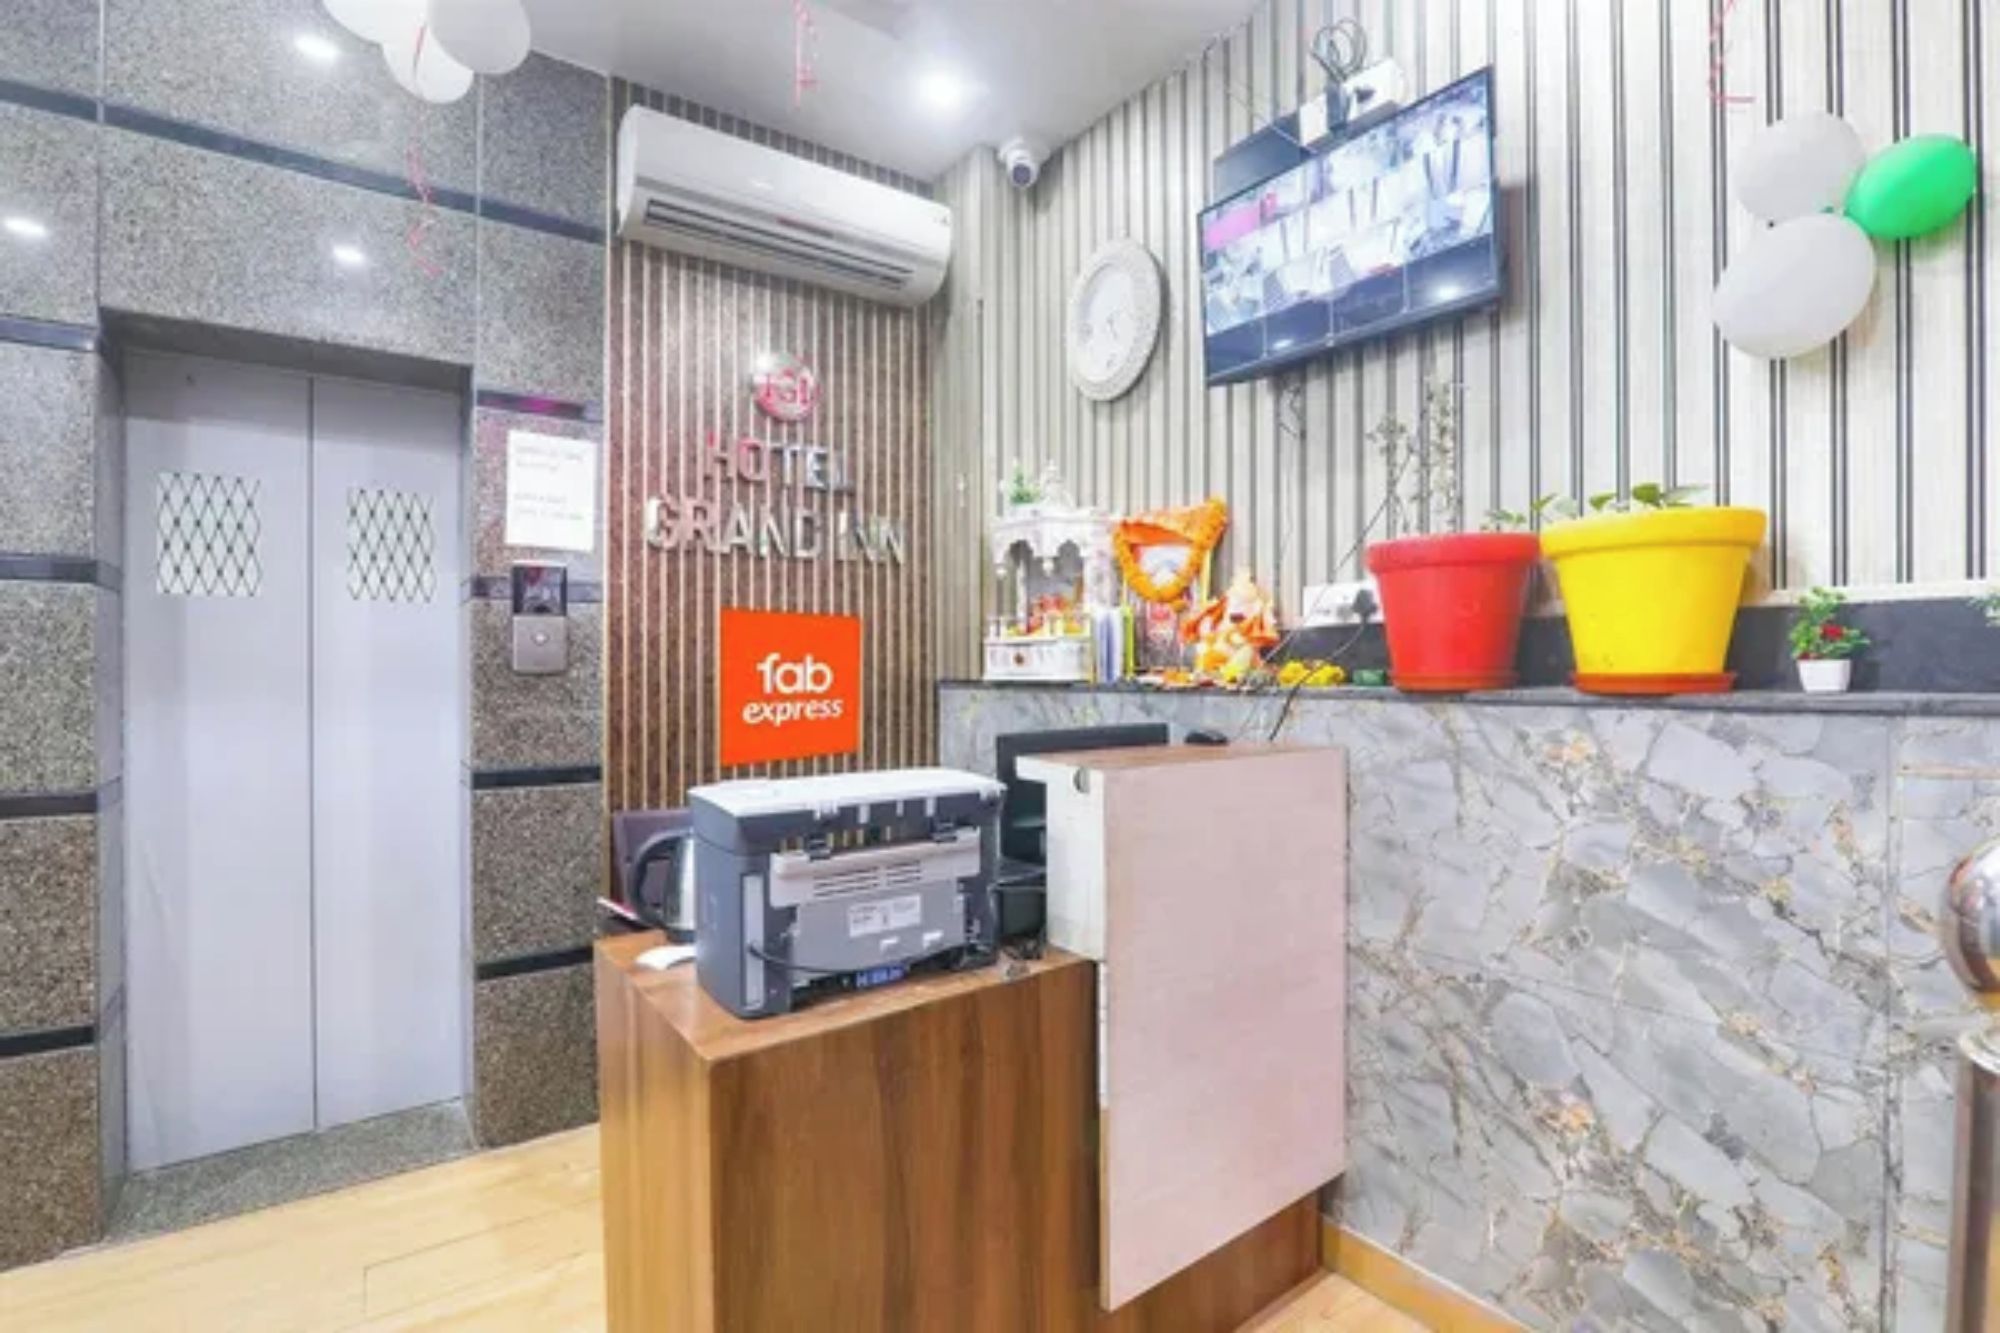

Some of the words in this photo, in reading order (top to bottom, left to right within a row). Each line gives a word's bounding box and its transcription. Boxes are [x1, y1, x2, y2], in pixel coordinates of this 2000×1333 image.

[705, 432, 855, 493] HOTEL
[645, 496, 824, 560] GRAND
[835, 507, 905, 566] INN
[756, 651, 834, 694] fab
[742, 699, 844, 727] express
